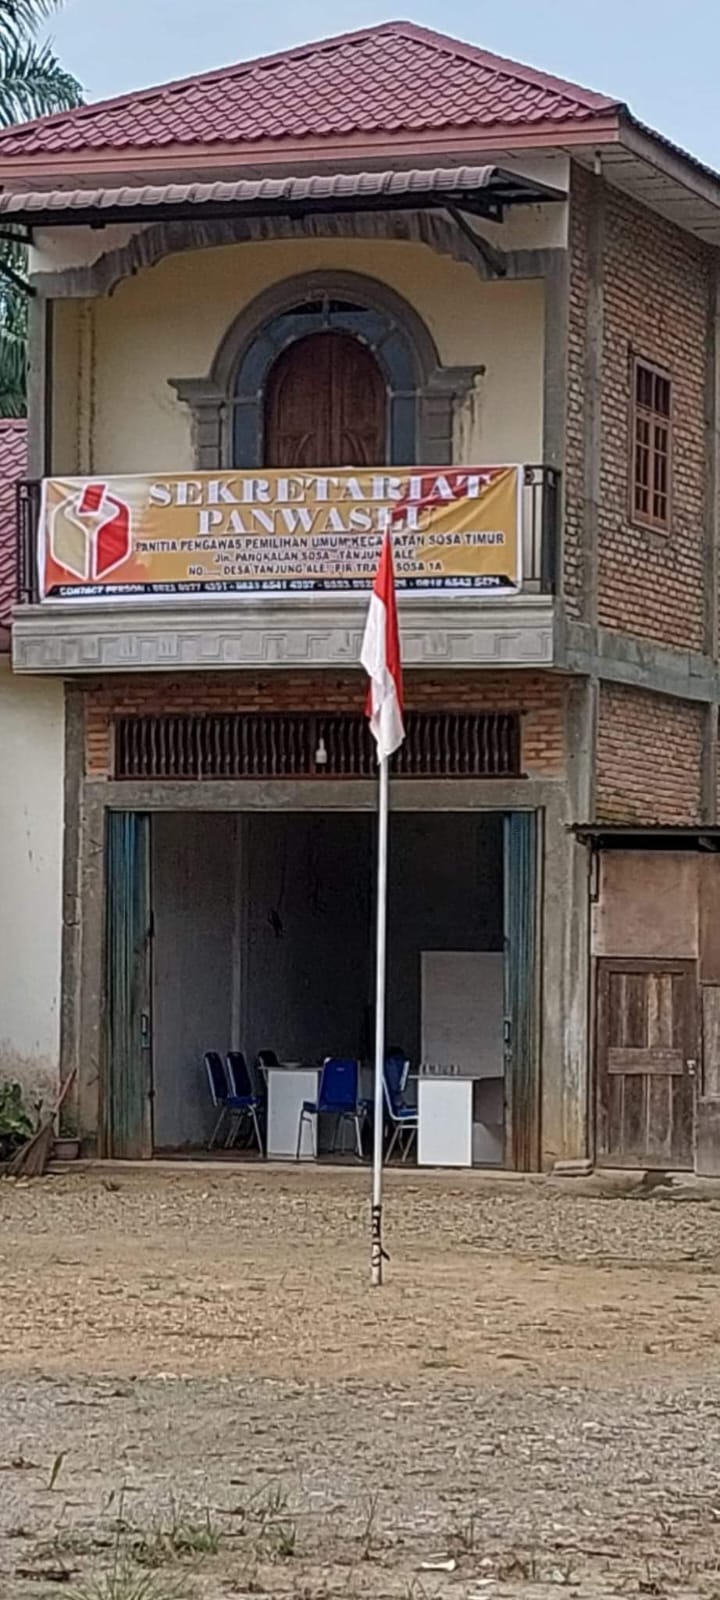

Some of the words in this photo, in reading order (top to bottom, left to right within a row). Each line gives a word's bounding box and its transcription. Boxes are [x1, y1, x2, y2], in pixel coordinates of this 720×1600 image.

[148, 475, 491, 507] SEKRETARIAT
[197, 506, 433, 534] PANWASLU
[136, 541, 177, 552] PANITIA
[180, 539, 242, 551] PENGAWAS
[245, 537, 308, 549] PEMILIHAN
[311, 537, 347, 548] UMUM
[351, 535, 425, 548] KECAATAN
[429, 534, 461, 545] SOSA
[465, 533, 504, 544] TIMUR
[235, 551, 299, 562] PANGKALAN
[301, 551, 329, 561] SOSA
[340, 549, 385, 560] TANJUN
[394, 549, 414, 559] ALE
[224, 565, 251, 575] DESA
[254, 563, 303, 575] TANJUNG
[396, 560, 425, 571] SOSA
[59, 585, 102, 596] CONTACT
[105, 584, 145, 594] PERSON
